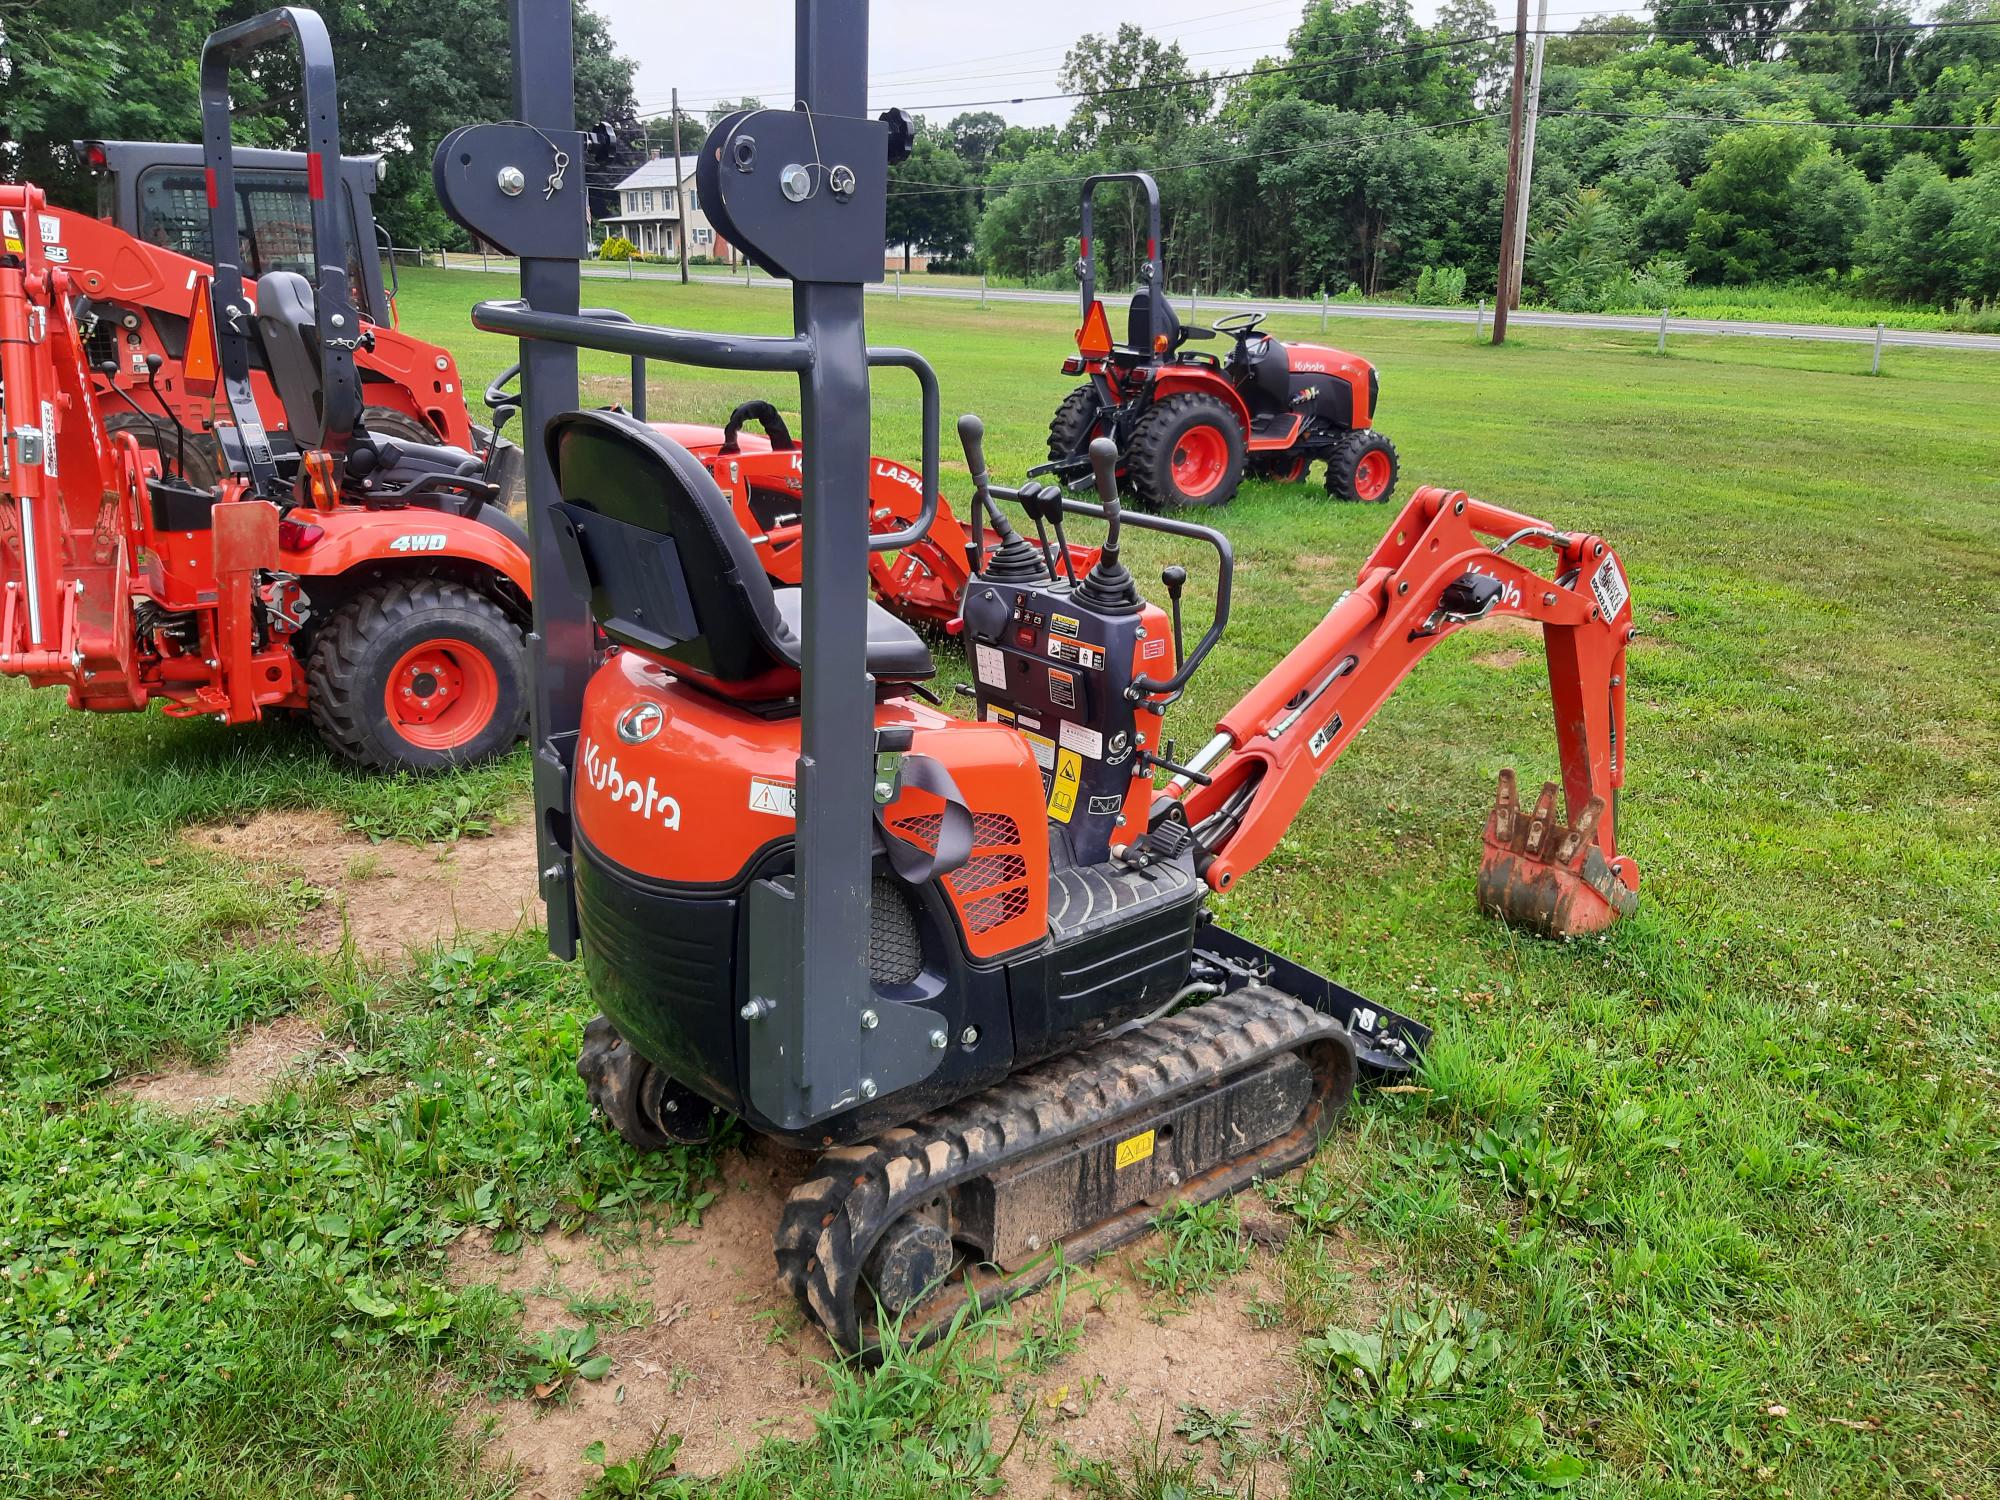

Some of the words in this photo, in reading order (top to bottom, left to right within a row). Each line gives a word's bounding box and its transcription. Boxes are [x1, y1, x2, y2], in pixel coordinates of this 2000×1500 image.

[1295, 362, 1325, 372] Kubota
[389, 535, 447, 551] 4WD
[583, 737, 681, 831] Kubota
